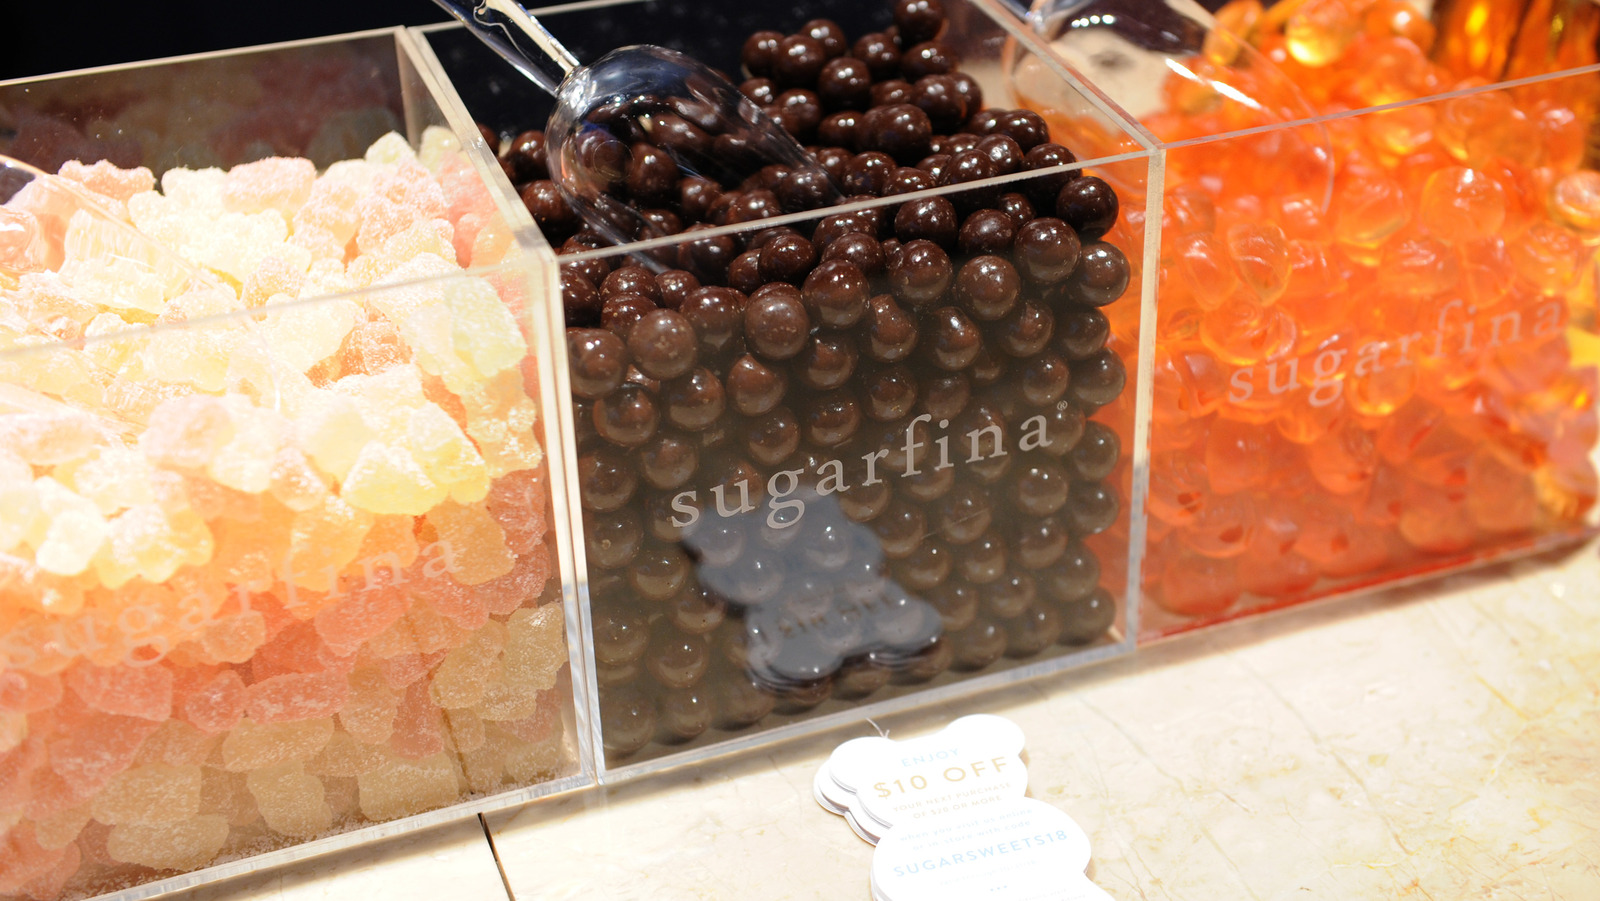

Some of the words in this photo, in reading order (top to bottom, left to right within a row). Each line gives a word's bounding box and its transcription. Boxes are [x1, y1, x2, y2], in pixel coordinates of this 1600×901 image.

[1227, 298, 1564, 408] sugarfina
[0, 538, 465, 669] sugarfina
[873, 775, 928, 800] $10
[943, 756, 1007, 782] OFF
[901, 748, 958, 767] ENJOY
[892, 801, 923, 813] YOUR
[925, 794, 952, 805] NEXT
[955, 782, 1012, 799] PURCHASE
[912, 811, 928, 820] OF
[952, 802, 968, 811] OR
[971, 795, 1003, 807] MORE
[893, 829, 1068, 877] SUGARSWEETS18
